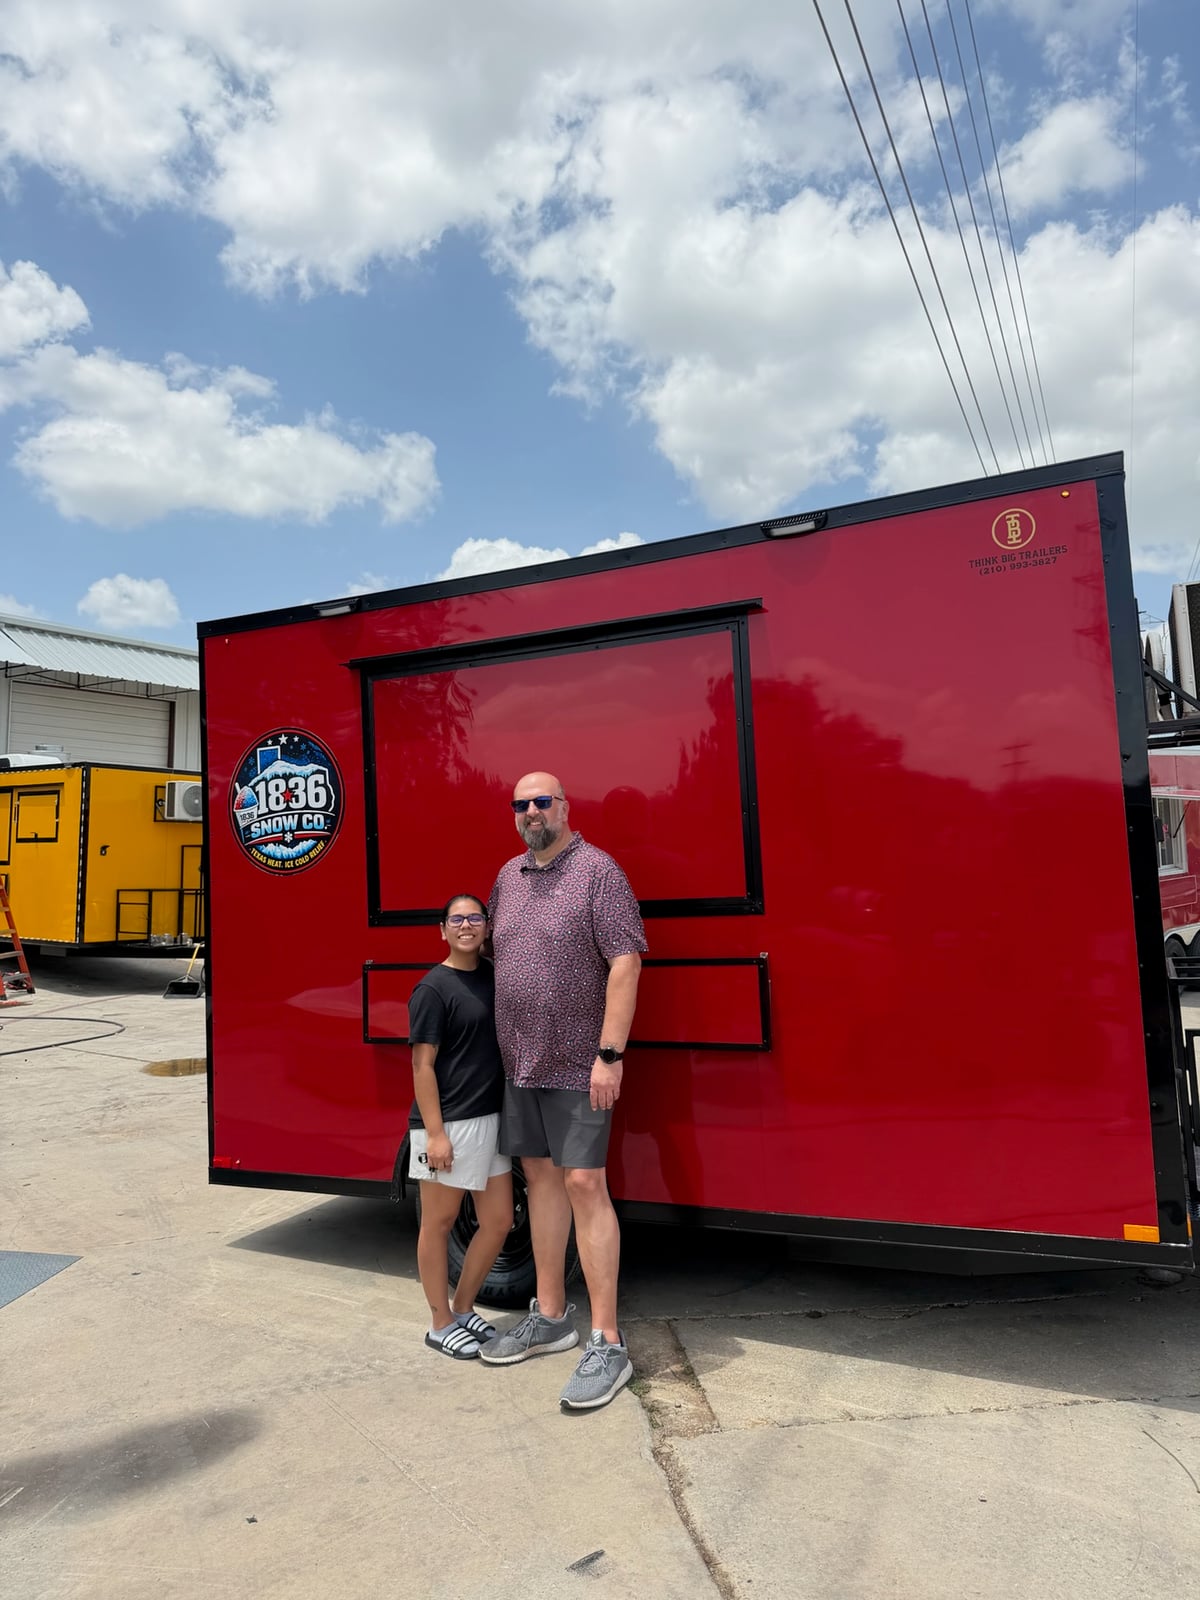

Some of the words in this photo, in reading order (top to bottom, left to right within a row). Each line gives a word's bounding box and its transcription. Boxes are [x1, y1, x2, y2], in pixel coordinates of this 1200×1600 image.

[968, 556, 998, 569] THINK
[1001, 553, 1017, 563] BIG
[1018, 545, 1068, 560] TRAILERS
[979, 565, 1006, 576] (210)
[1010, 556, 1057, 570] 993-3827
[255, 774, 327, 815] 1836
[250, 814, 299, 839] SNOW
[302, 813, 328, 830] CO.
[250, 848, 267, 864] TEXAS
[284, 860, 294, 869] ICE
[294, 854, 310, 866] COLD
[308, 840, 326, 858] RELIEF
